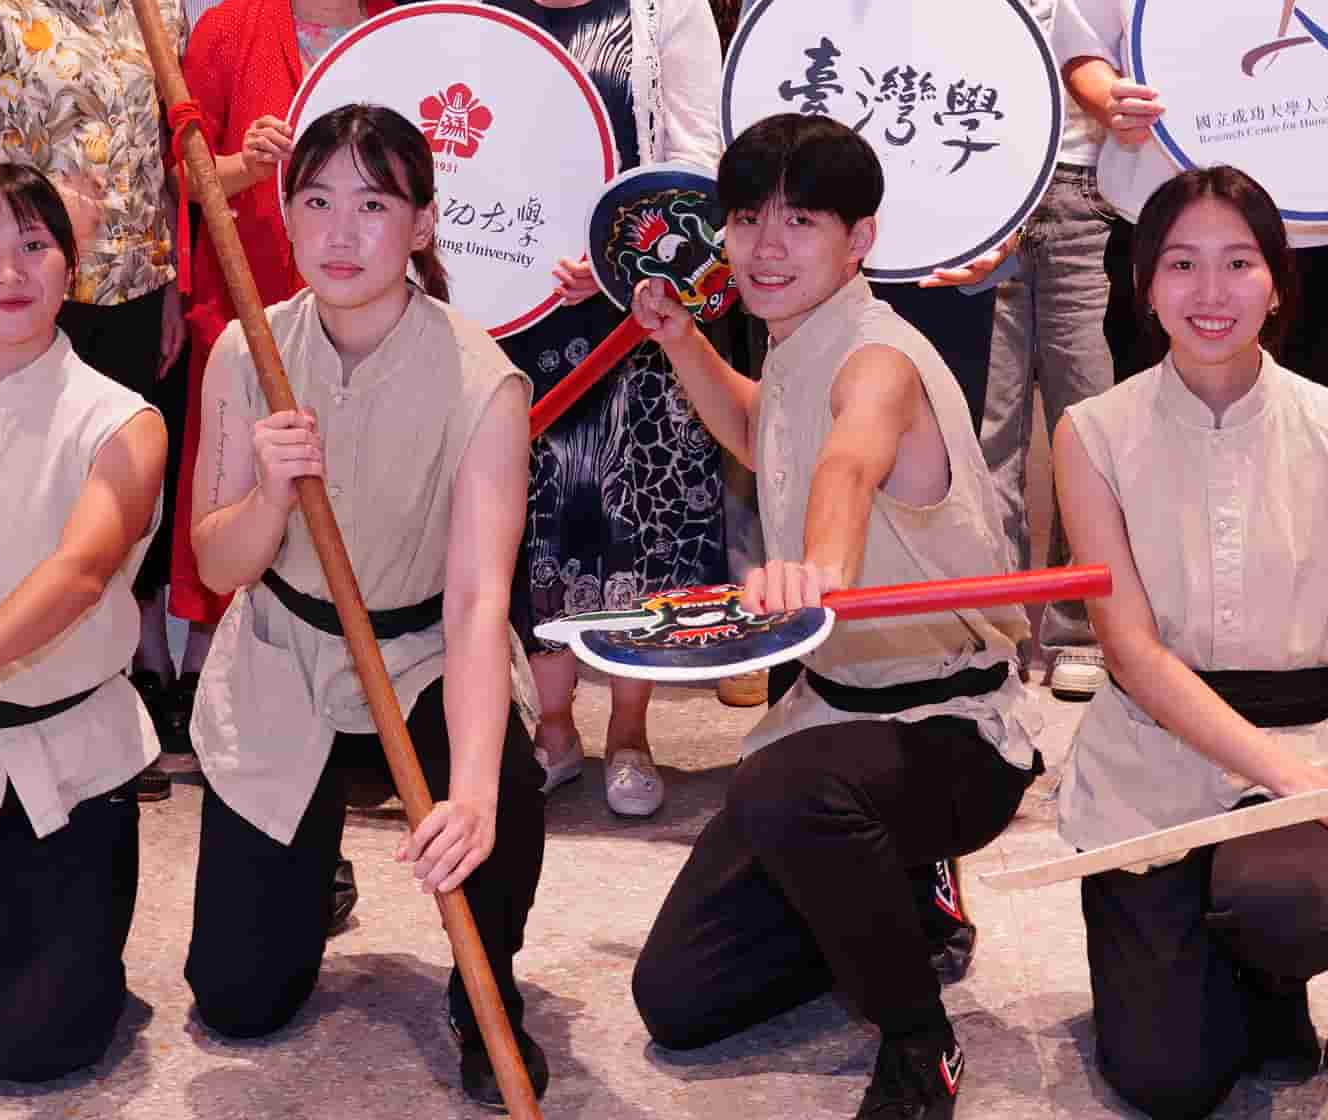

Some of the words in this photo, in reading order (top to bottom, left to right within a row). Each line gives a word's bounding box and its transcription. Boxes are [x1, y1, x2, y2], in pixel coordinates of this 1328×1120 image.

[434, 197, 545, 248] 功大學
[466, 241, 534, 269] University
